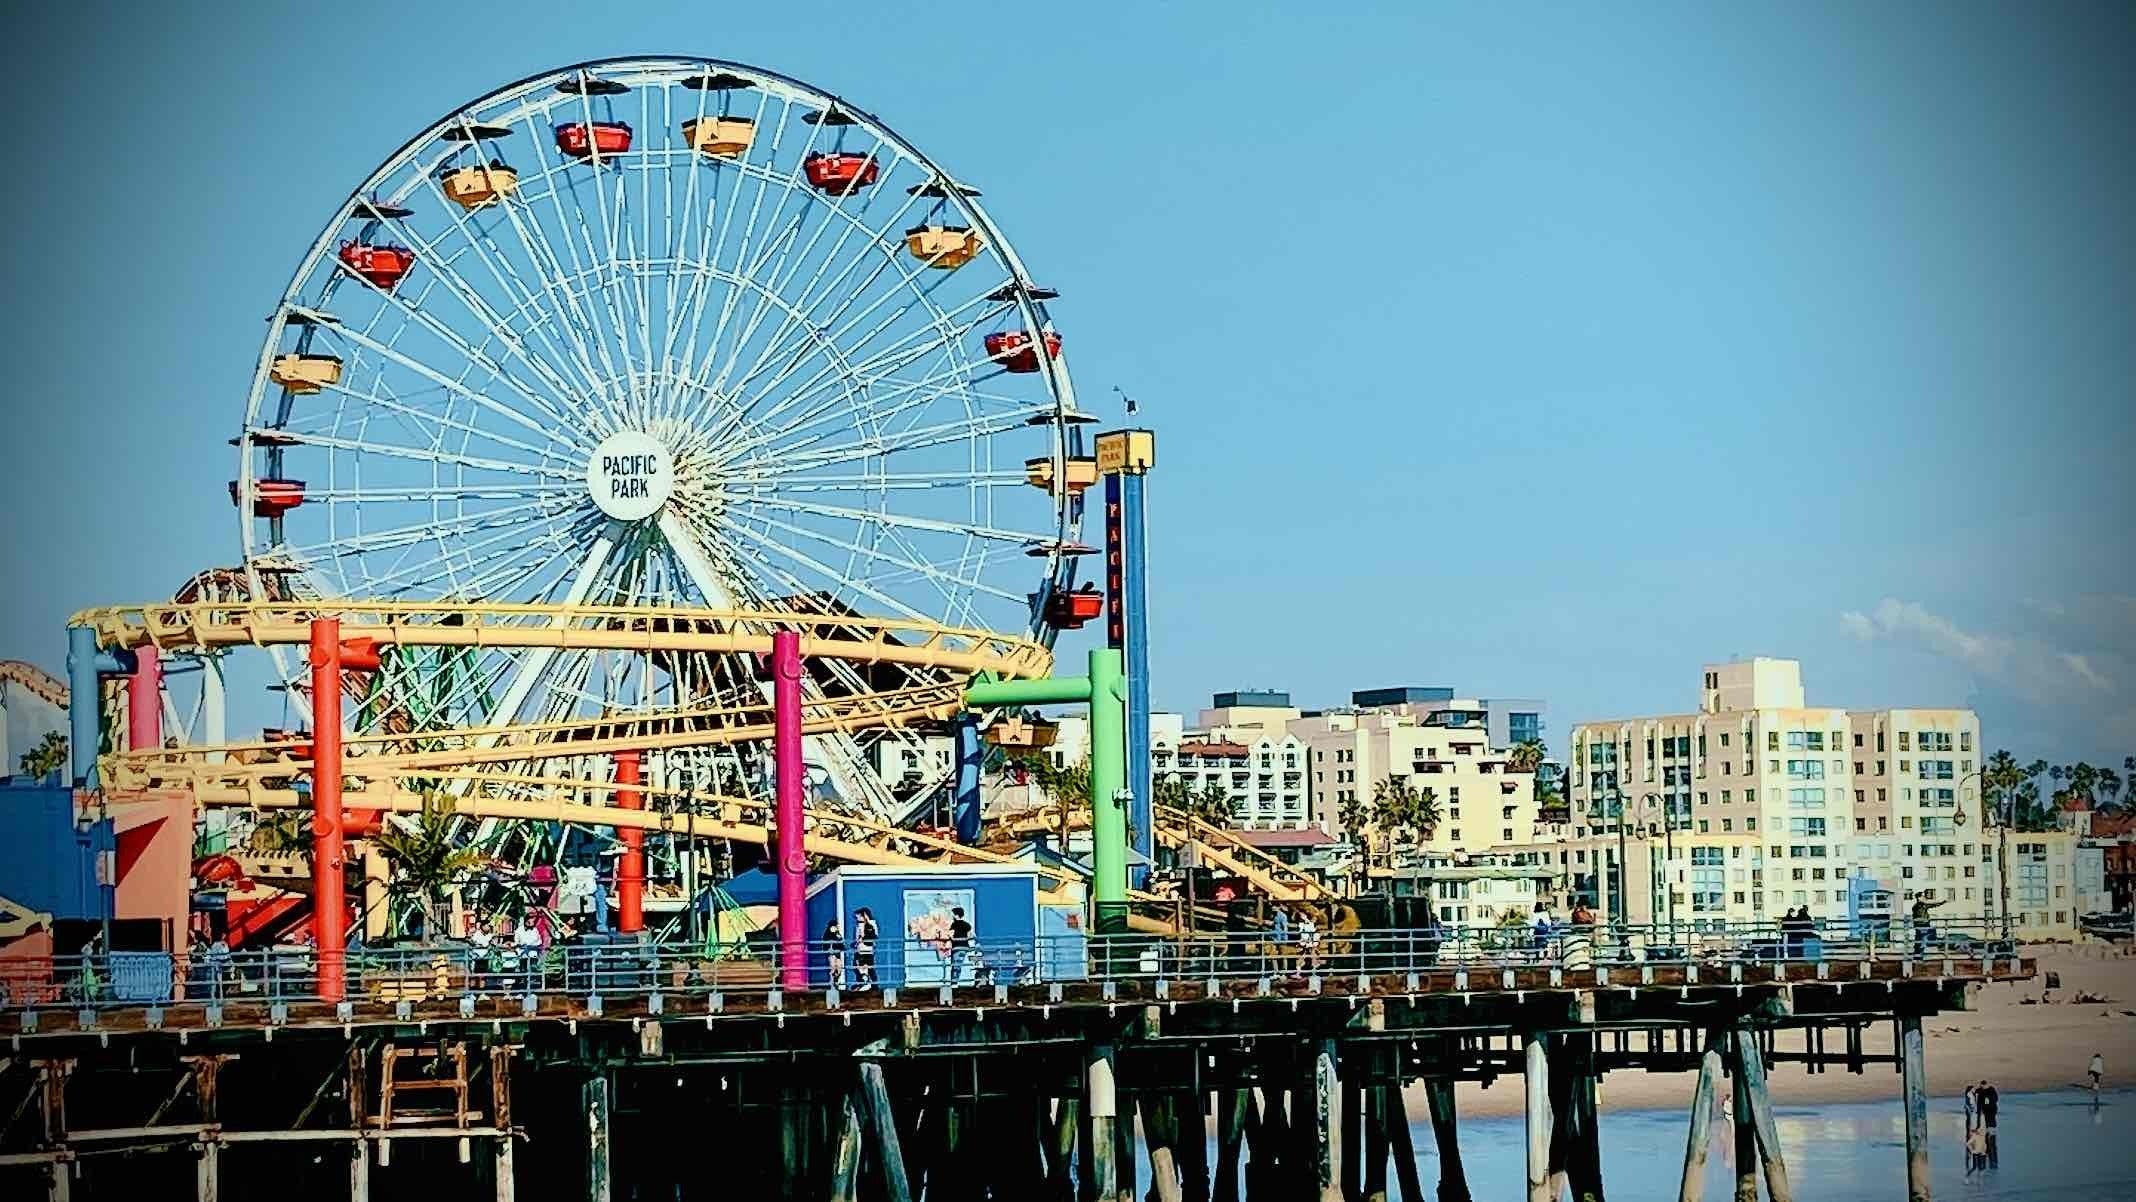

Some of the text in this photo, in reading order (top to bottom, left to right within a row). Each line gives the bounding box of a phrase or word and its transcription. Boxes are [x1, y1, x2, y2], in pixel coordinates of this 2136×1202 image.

[603, 454, 657, 475] PACIFIC
[611, 478, 649, 498] PARK
[1108, 502, 1122, 640] PACIFI
